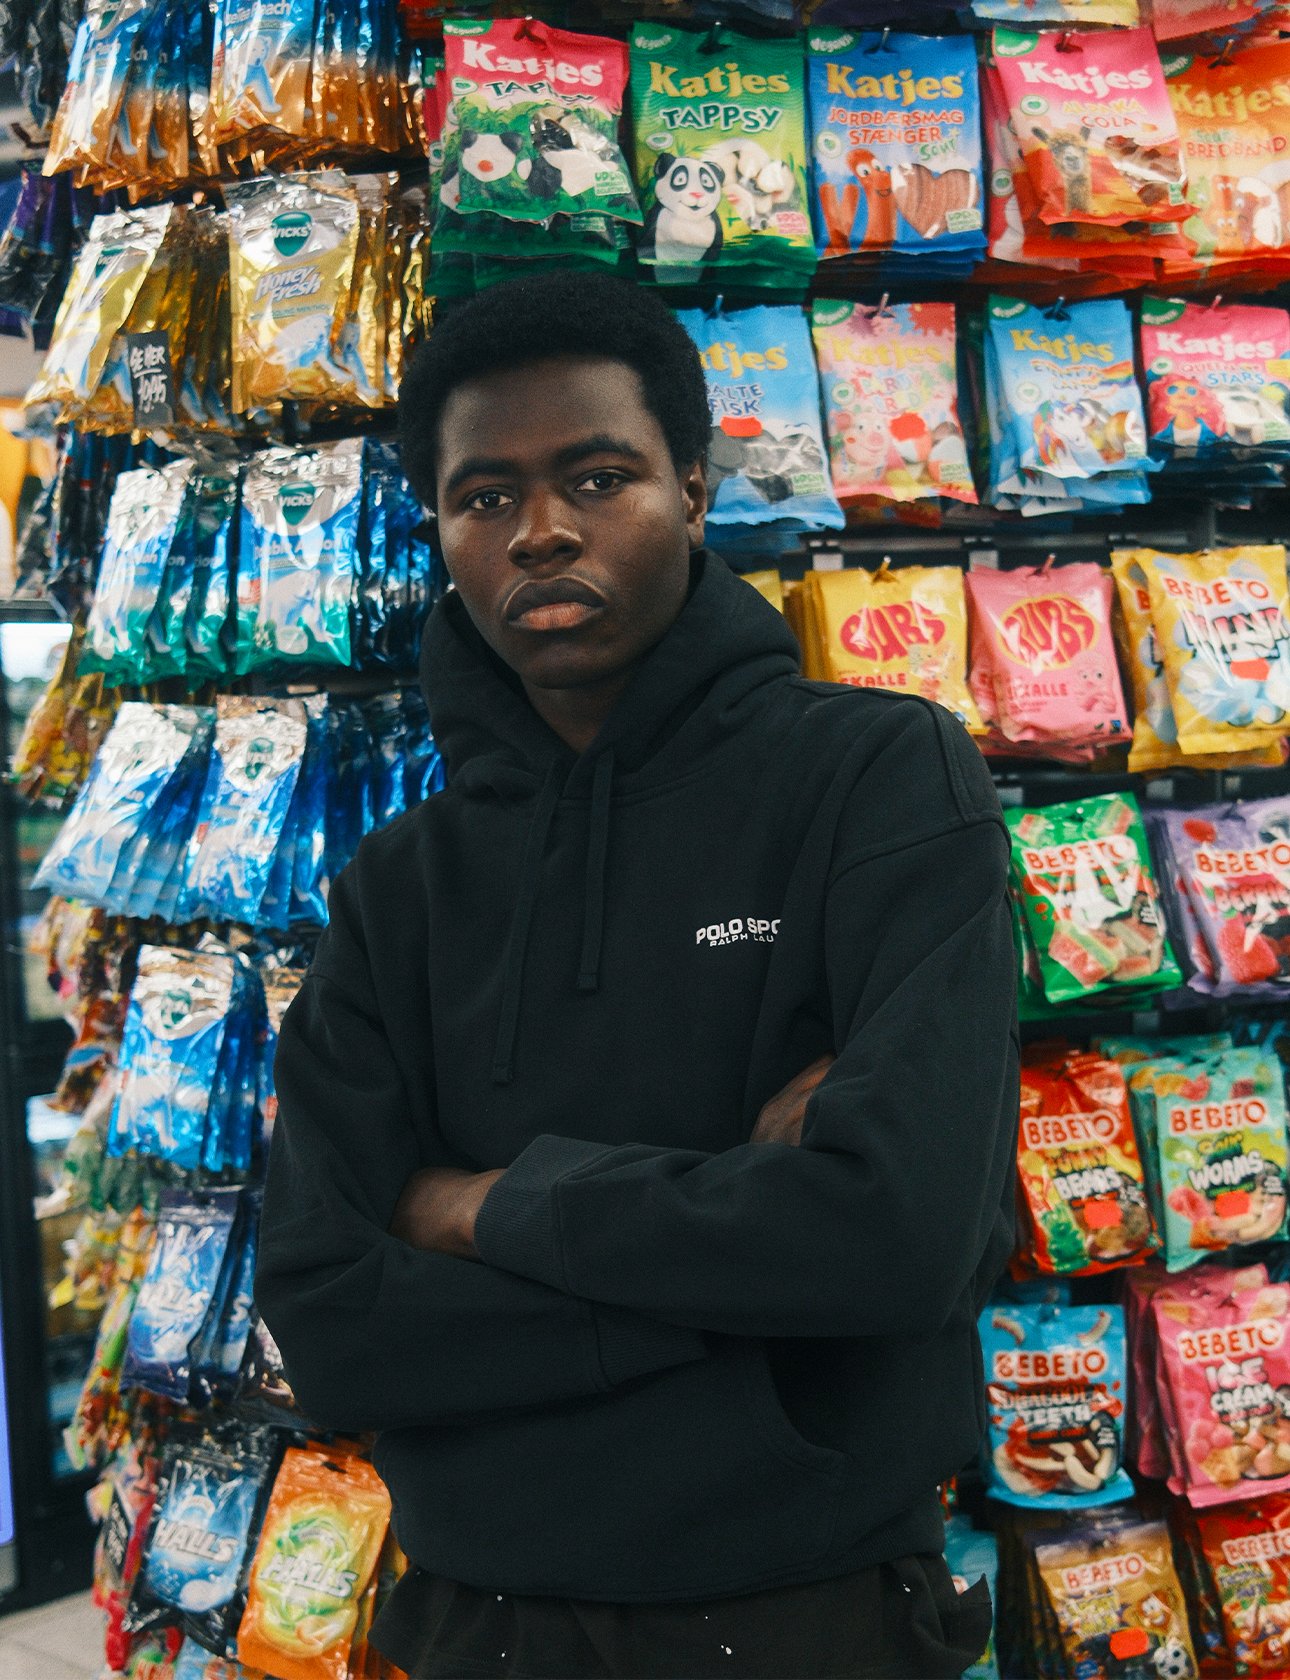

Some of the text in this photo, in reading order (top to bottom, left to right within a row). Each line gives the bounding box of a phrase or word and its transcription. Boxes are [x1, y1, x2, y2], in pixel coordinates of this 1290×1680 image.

[462, 39, 605, 87] Katjes
[649, 61, 791, 99] Katjes
[826, 62, 964, 107] Katjes
[1017, 62, 1153, 99] Katjes
[661, 103, 782, 131] TAPPSY
[830, 108, 965, 127] JORDBÆRSMAG
[1081, 114, 1138, 128] COLA
[848, 128, 942, 146] STÆNGER
[255, 265, 319, 301] Honey
[832, 339, 944, 369] Katjes
[1009, 329, 1115, 365] Katjes
[1156, 331, 1276, 361] Katjes
[1207, 371, 1265, 386] STARS
[709, 398, 760, 417] FISK
[1163, 577, 1270, 605] BEBETO
[1196, 843, 1290, 874] BEBETO
[696, 918, 743, 945] POLO
[709, 933, 748, 947] RALPH
[1026, 1114, 1114, 1145] BEBETO
[1170, 1100, 1266, 1134] BEBETO
[1190, 1150, 1264, 1193] WORMS
[1181, 1323, 1281, 1360] BEBETO
[995, 1350, 1105, 1379] BEBETO
[1205, 1357, 1267, 1391] ICE
[154, 1519, 239, 1565] HALLS
[260, 1551, 360, 1600] HALLS
